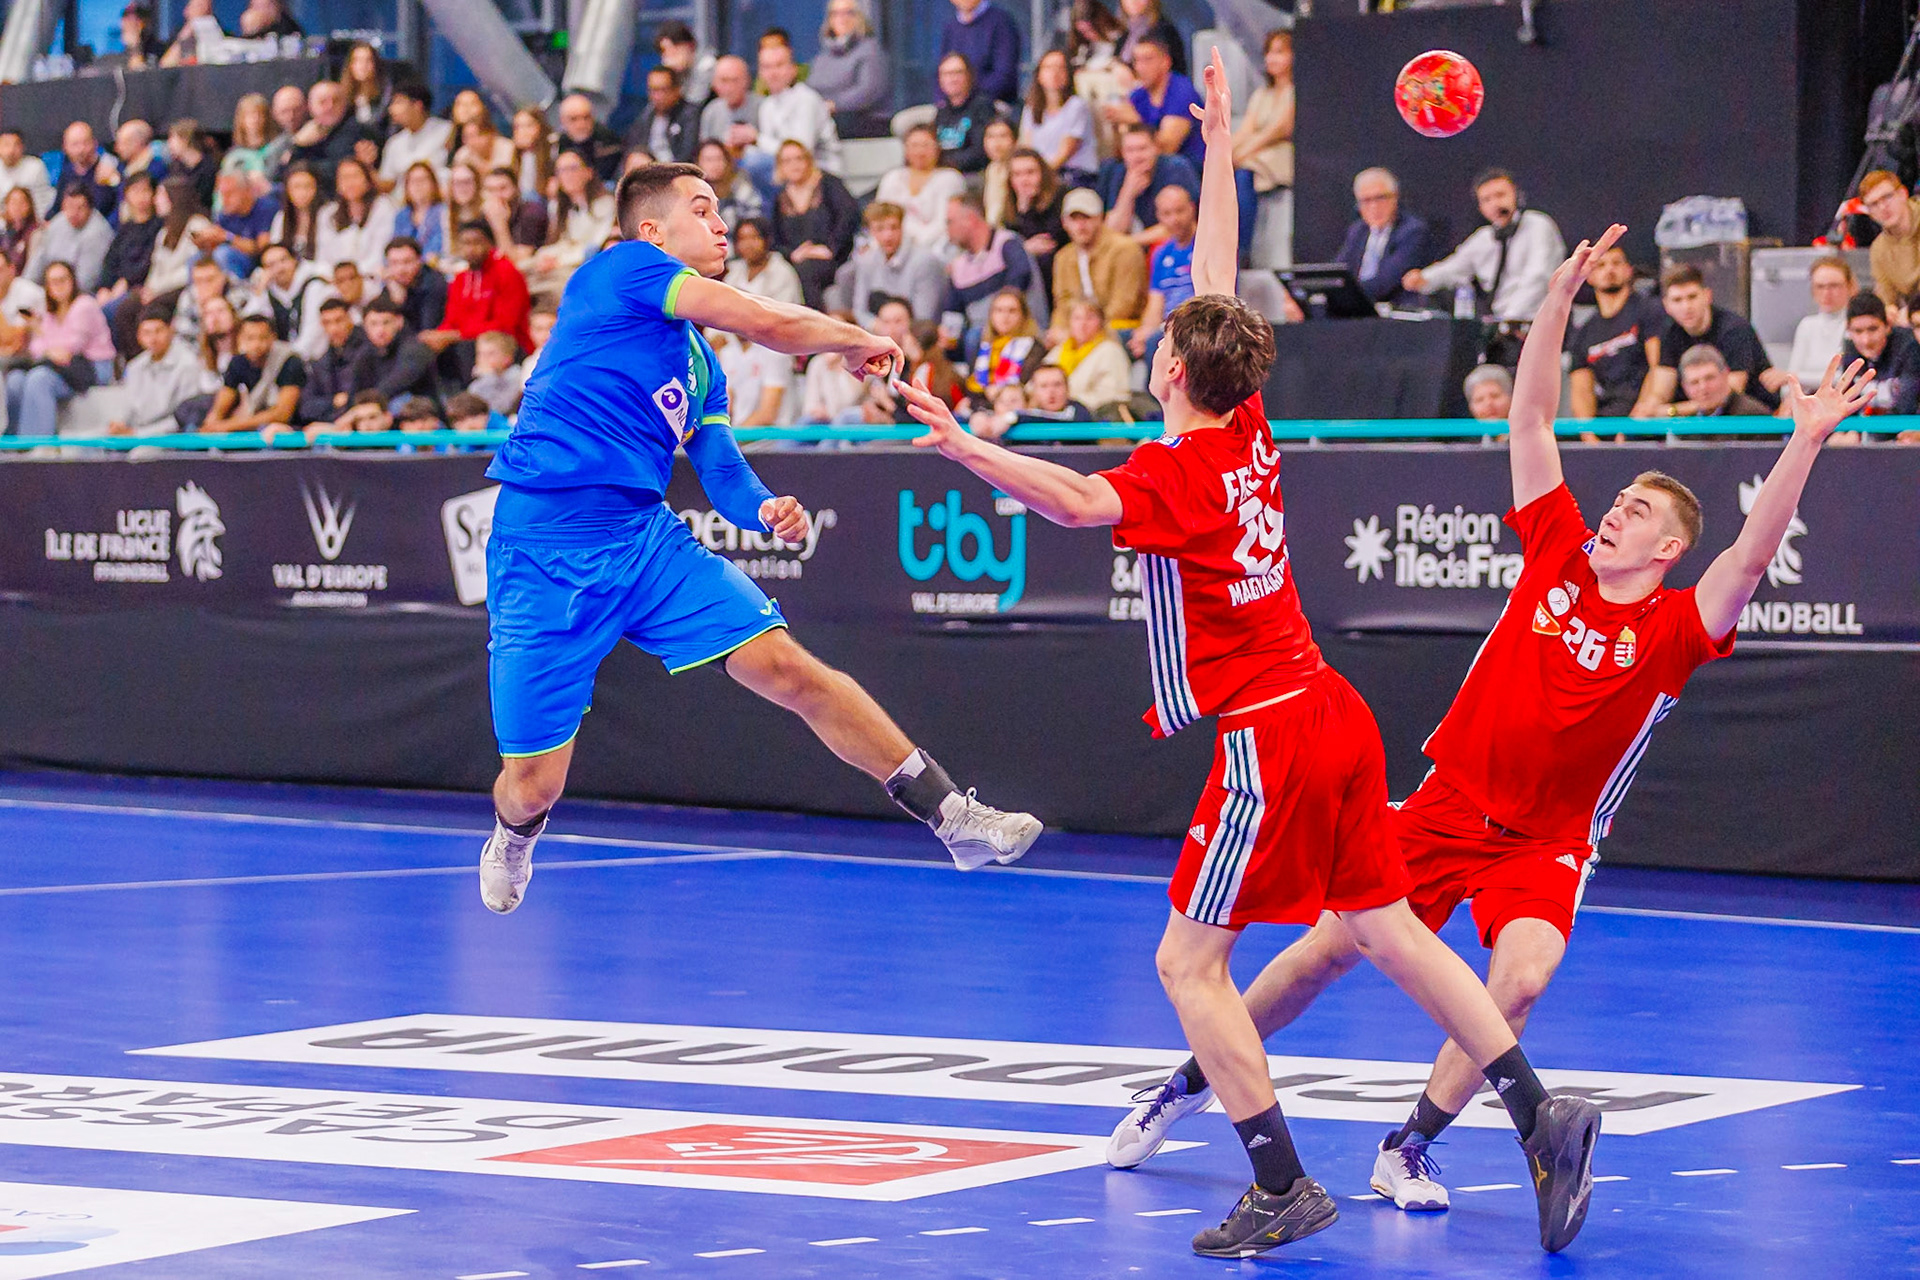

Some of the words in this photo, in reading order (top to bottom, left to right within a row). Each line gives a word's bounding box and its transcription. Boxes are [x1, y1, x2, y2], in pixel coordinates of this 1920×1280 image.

[116, 509, 171, 534] LIGUE
[1396, 503, 1500, 552] Région
[99, 533, 171, 561] FRANCE
[272, 563, 305, 588] VAL
[1562, 616, 1607, 671] 26
[0, 1102, 509, 1143] CAISS
